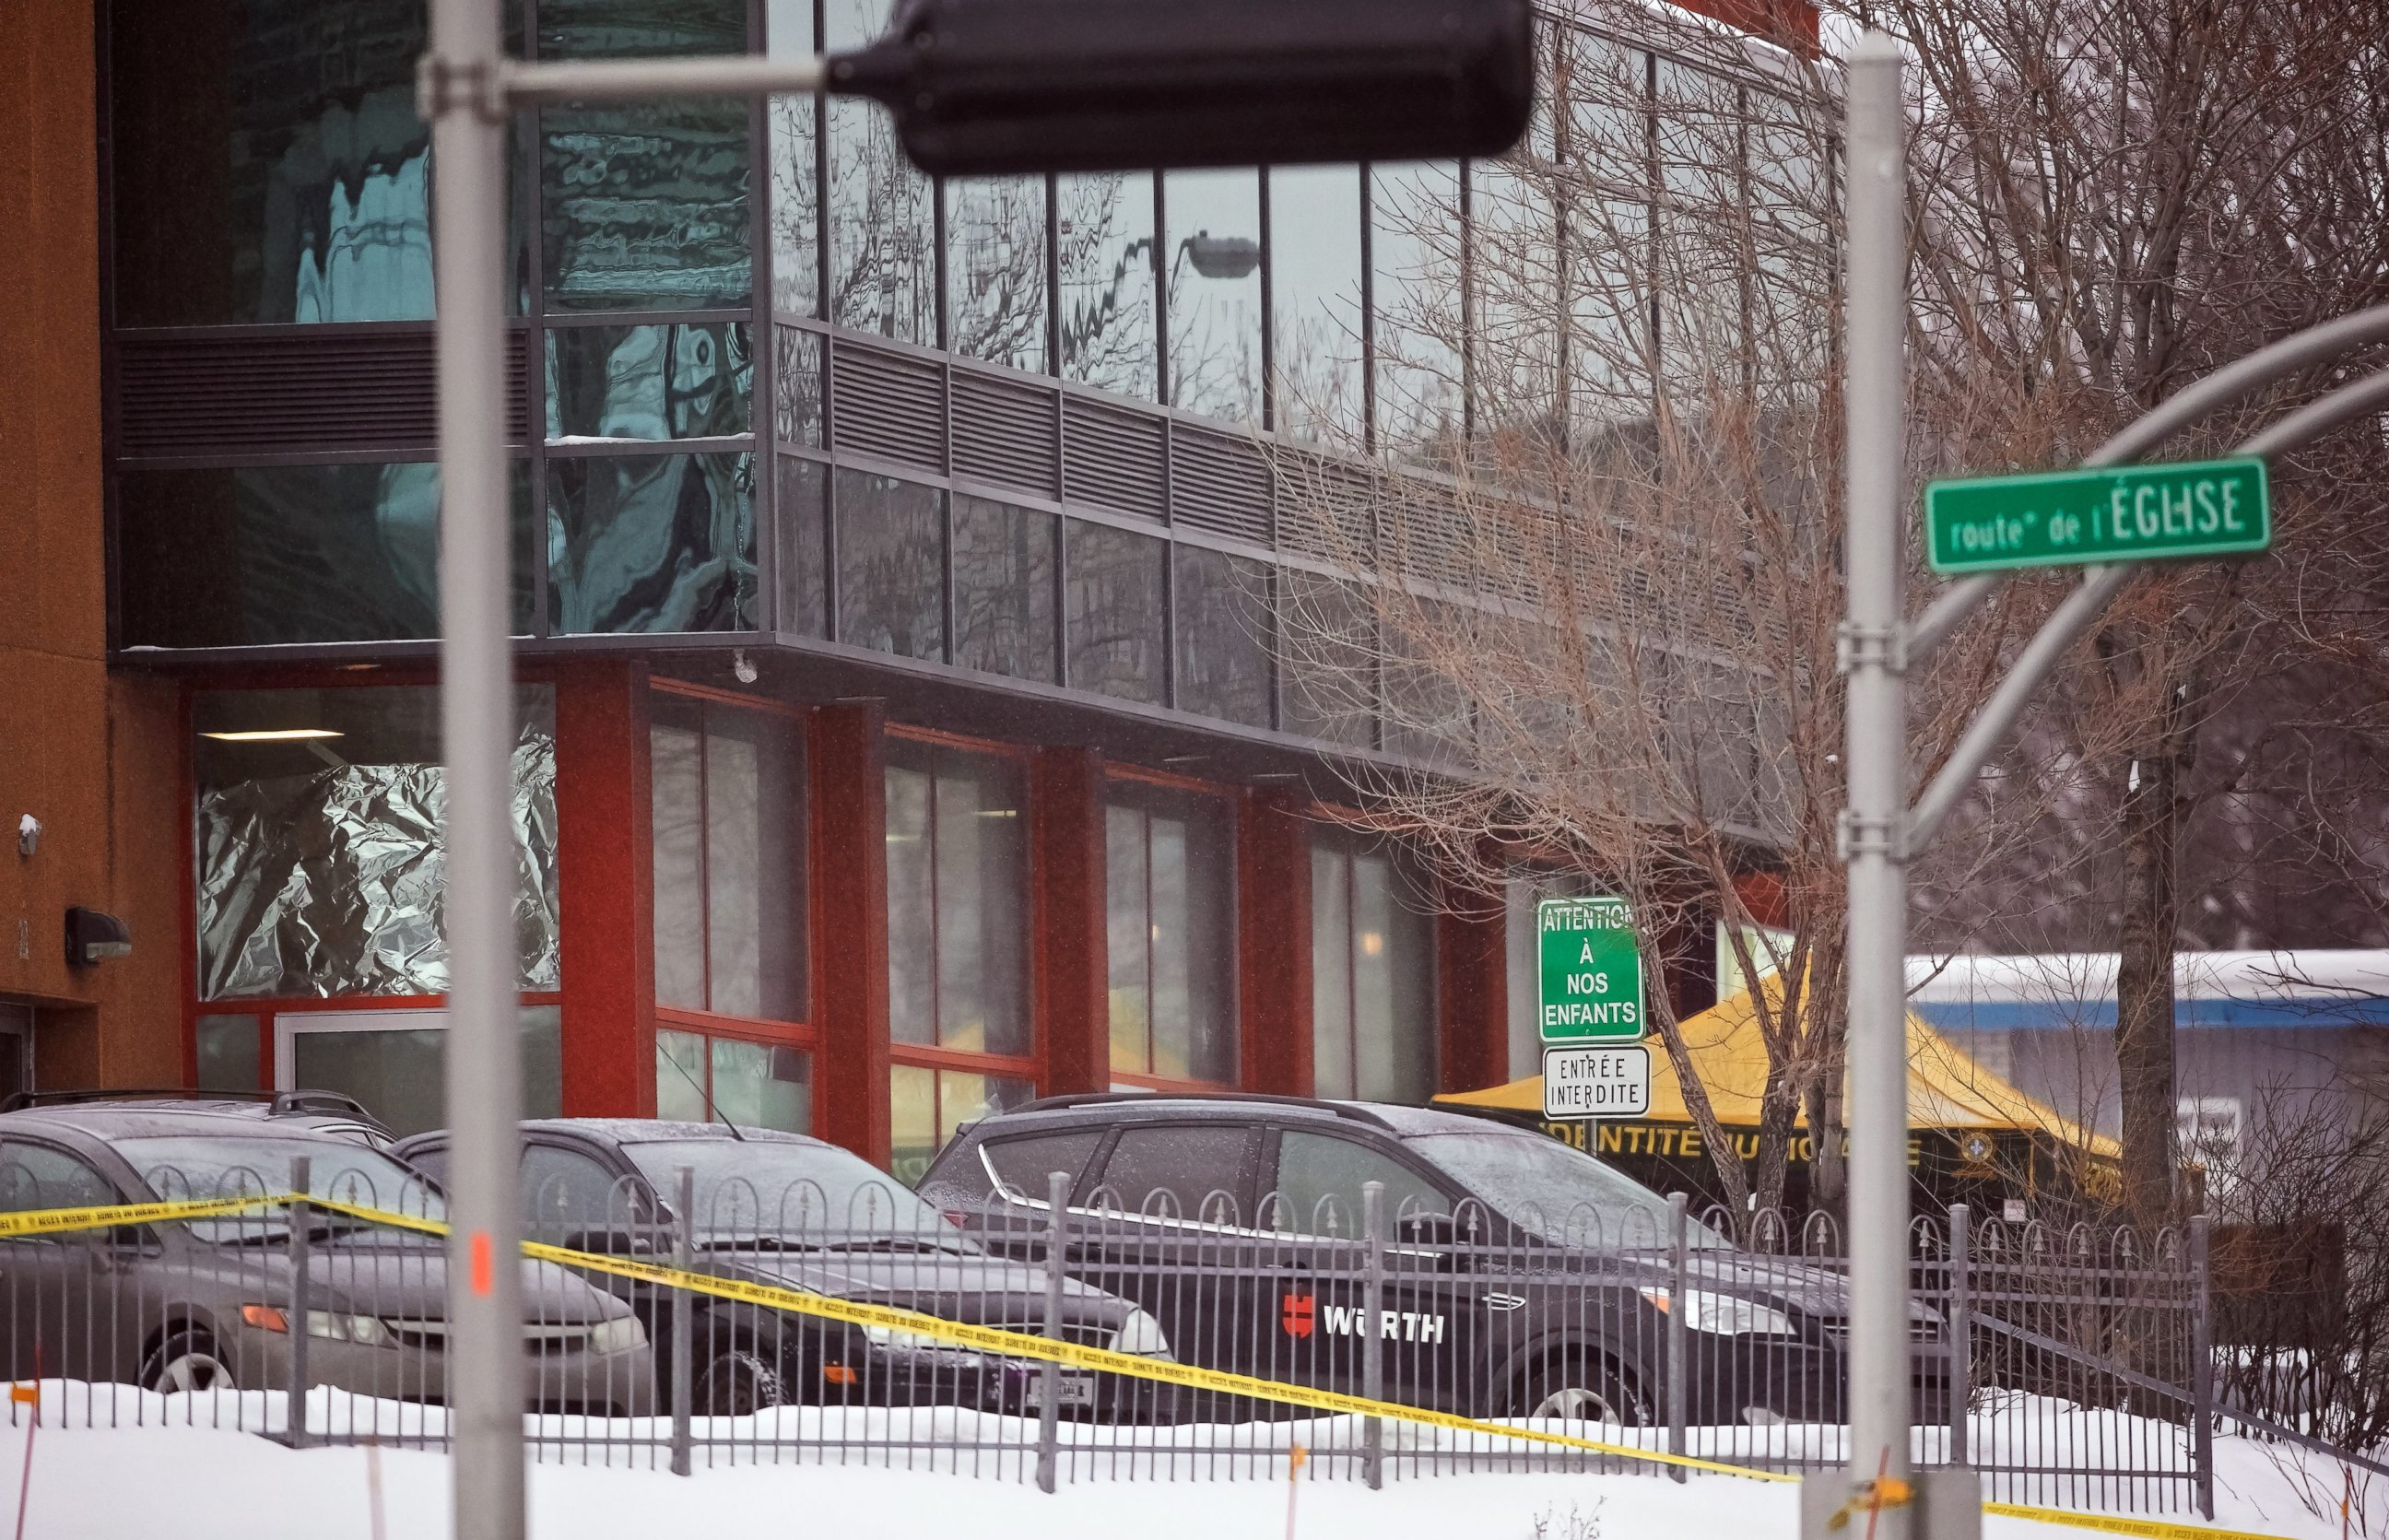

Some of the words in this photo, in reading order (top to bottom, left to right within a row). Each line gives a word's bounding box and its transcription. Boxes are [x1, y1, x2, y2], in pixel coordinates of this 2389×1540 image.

[1950, 513, 2023, 554] route
[2048, 509, 2081, 546] de
[1580, 937, 1594, 964] À
[1567, 972, 1608, 995] NOS
[1545, 1002, 1636, 1027] ENFANTS
[1560, 1053, 1626, 1079] ENTRÉE
[1551, 1084, 1639, 1106] INTERDITE
[1538, 1123, 1702, 1158] DENTITÉ
